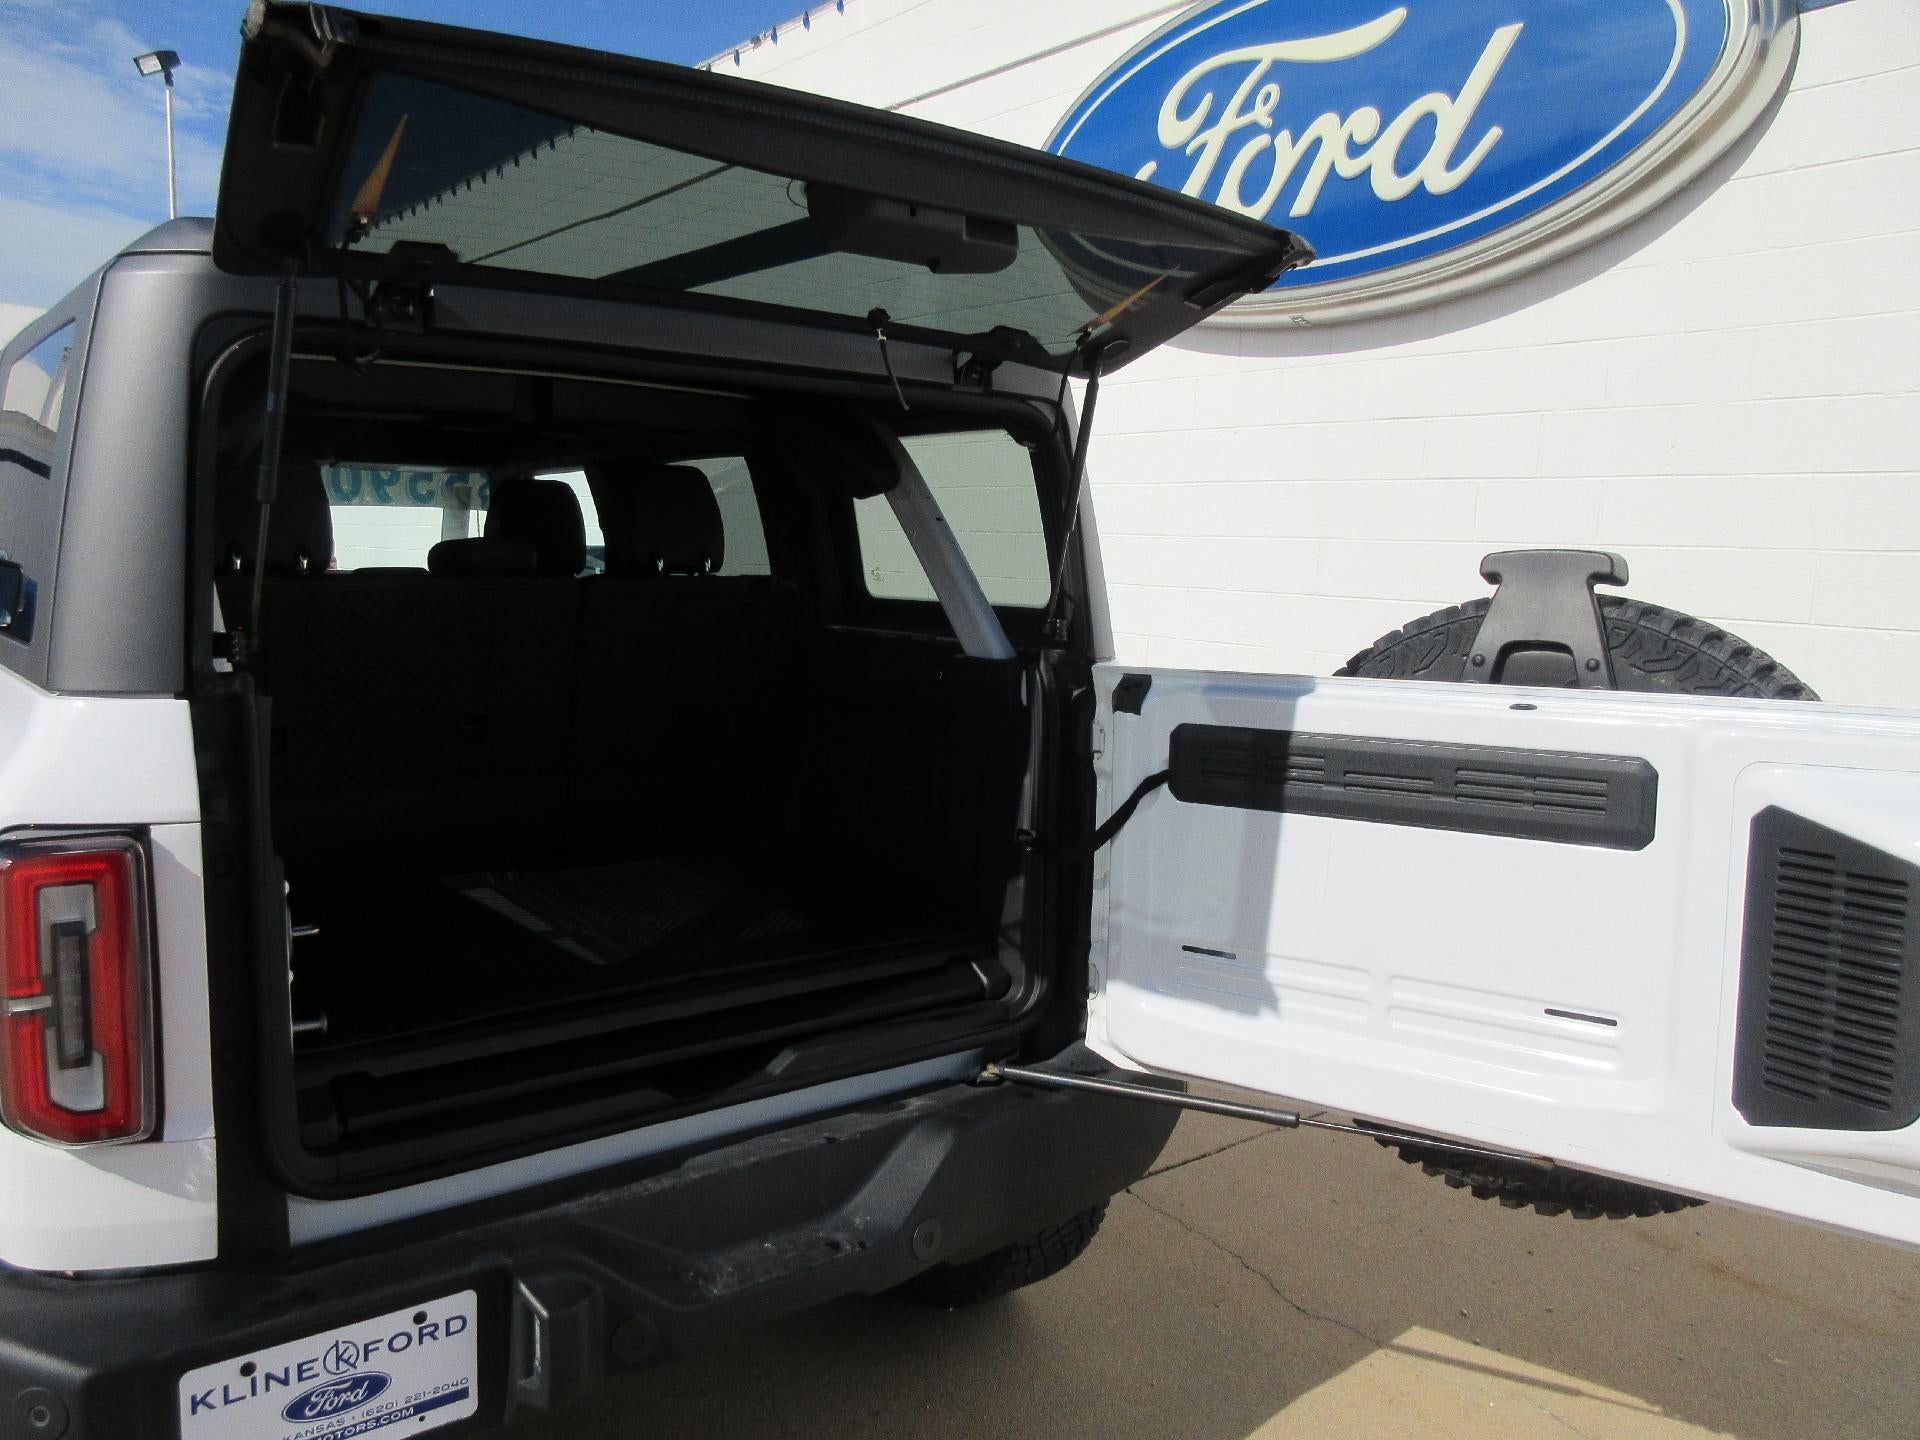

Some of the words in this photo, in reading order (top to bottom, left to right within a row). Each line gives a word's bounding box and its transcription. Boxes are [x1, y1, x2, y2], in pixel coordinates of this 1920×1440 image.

[1135, 7, 1523, 219] Ford
[190, 1357, 320, 1416] KLINE
[363, 1314, 468, 1363] FORD
[304, 1379, 370, 1417] Ford
[404, 1377, 469, 1404] 221-2040
[316, 1406, 414, 1440] OTORS.COM
